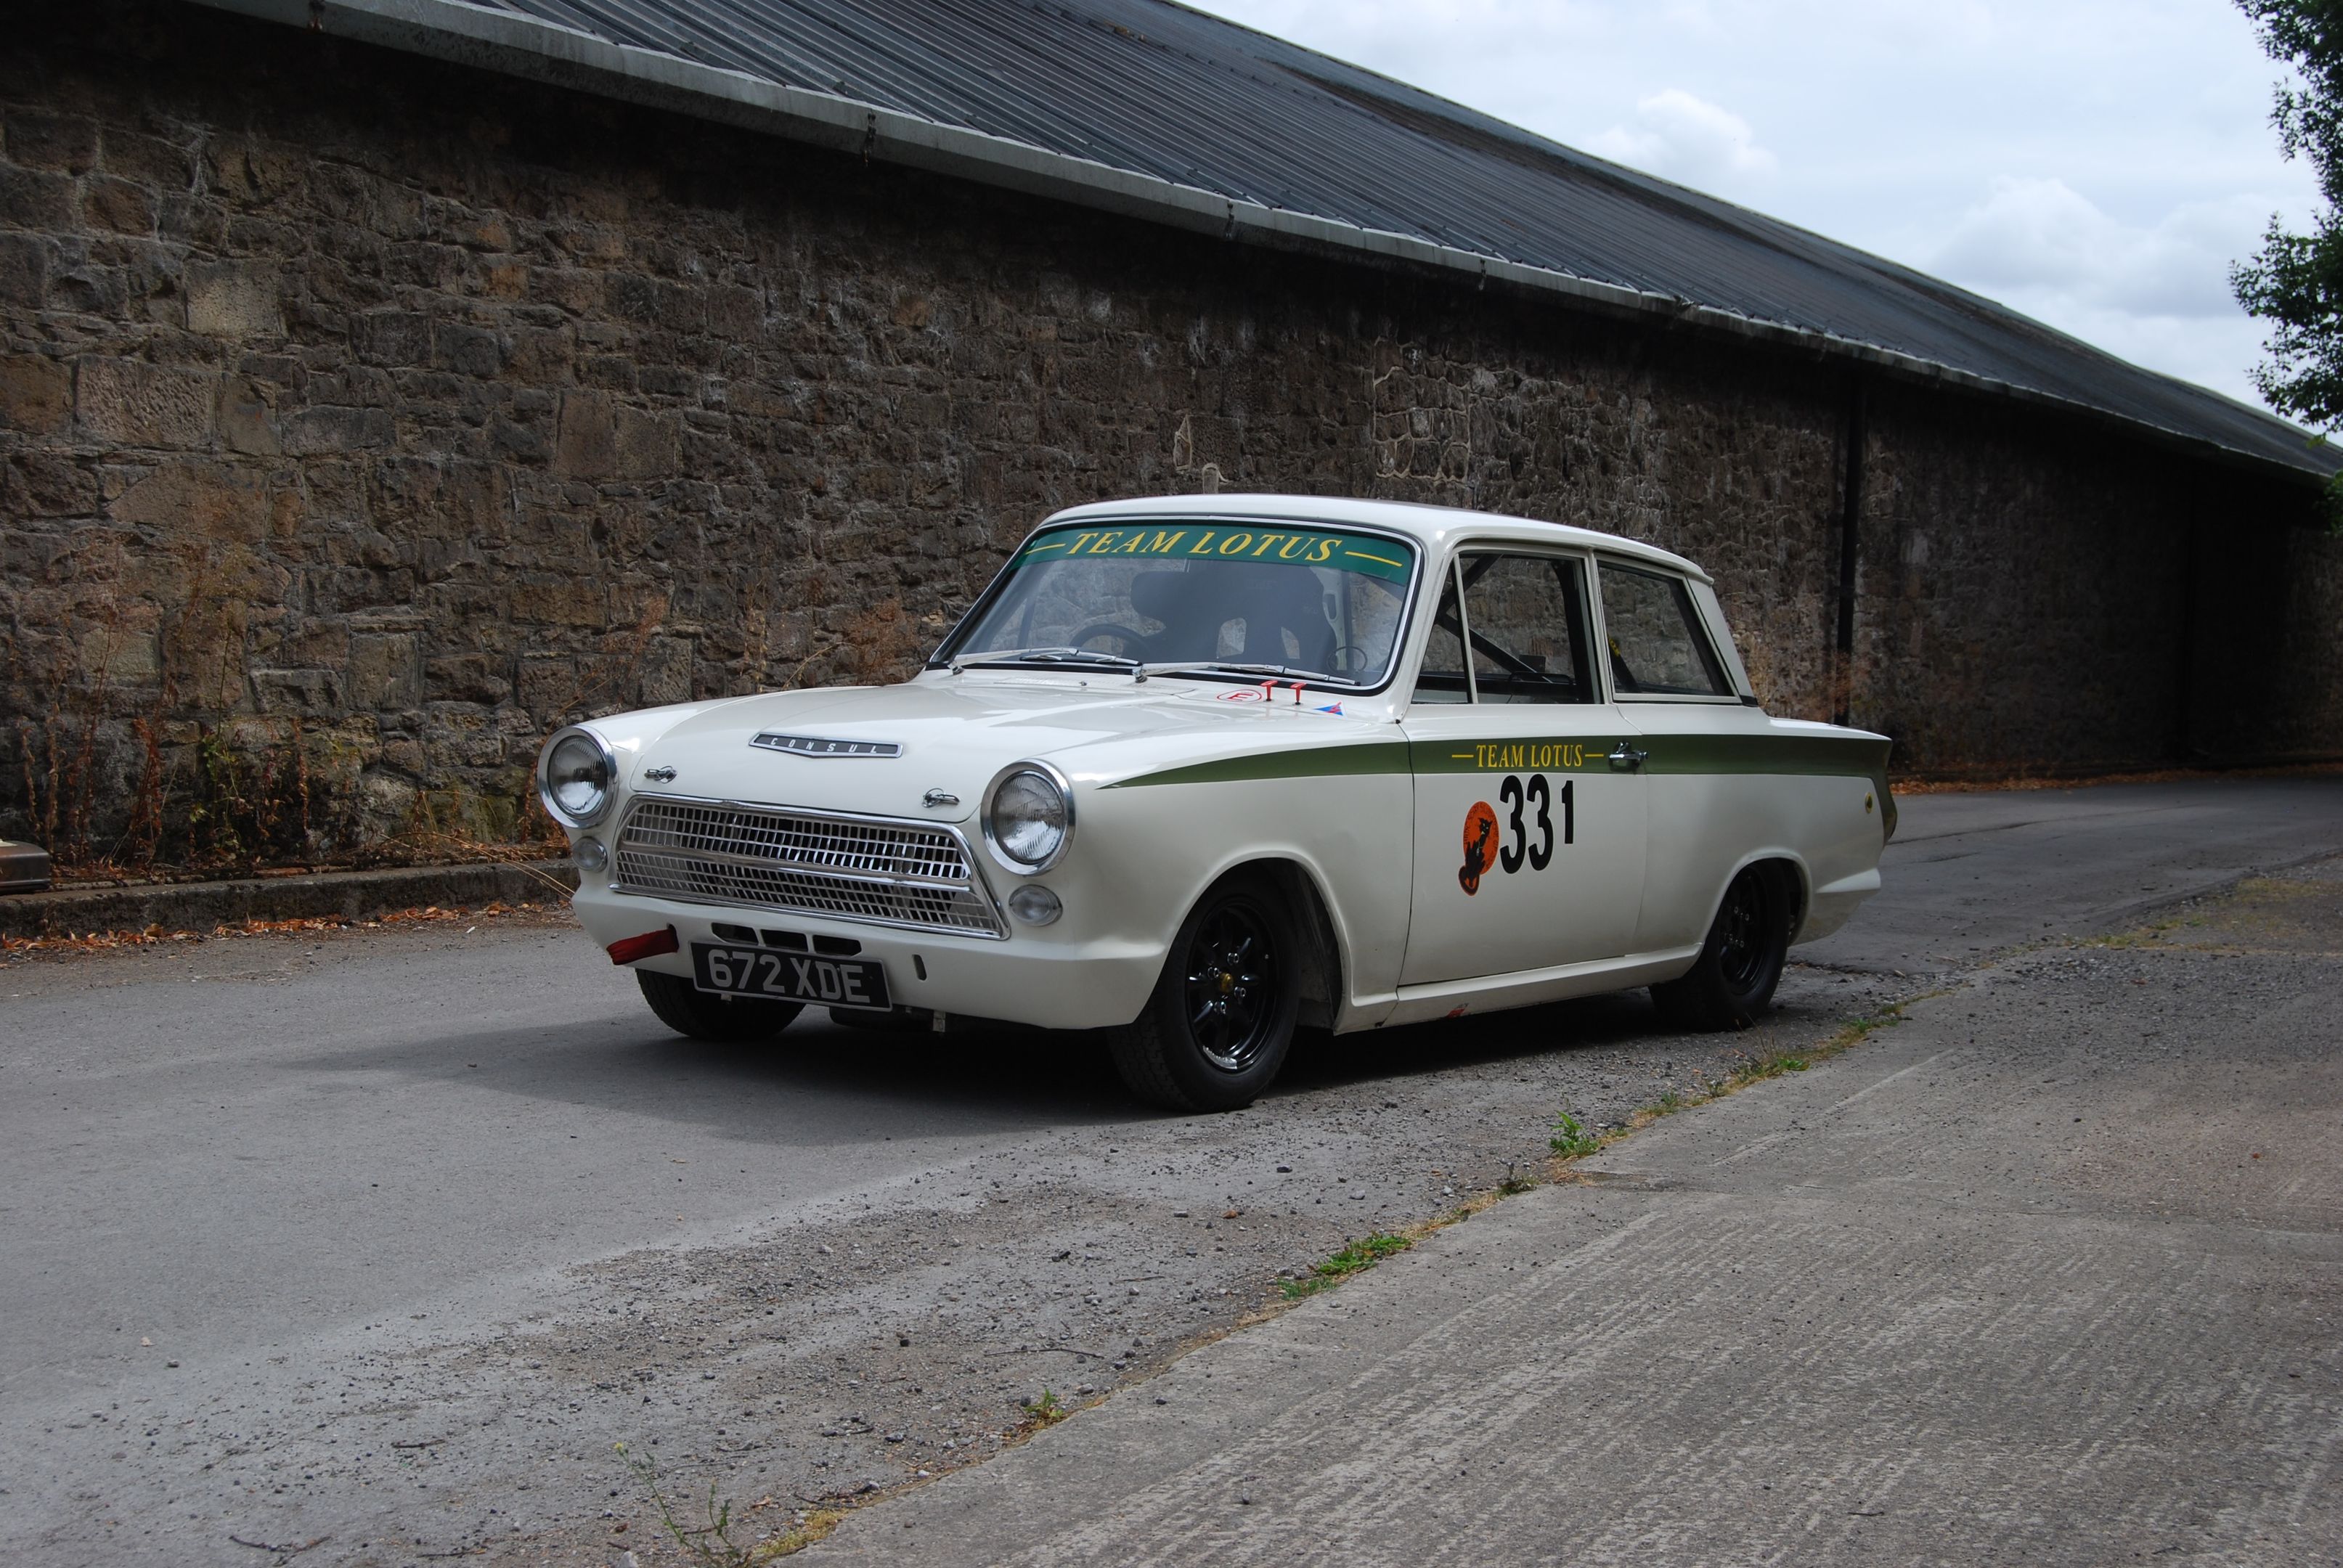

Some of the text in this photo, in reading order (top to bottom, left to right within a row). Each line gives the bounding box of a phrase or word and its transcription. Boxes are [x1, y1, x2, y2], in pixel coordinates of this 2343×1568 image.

[1066, 531, 1342, 562] TEAM LOTUS
[1227, 692, 1254, 702] E
[770, 738, 877, 754] CONSUL
[1476, 744, 1582, 767] TEAM LOTUS
[1499, 773, 1573, 874] 331
[708, 949, 871, 1003] 672 XDE
